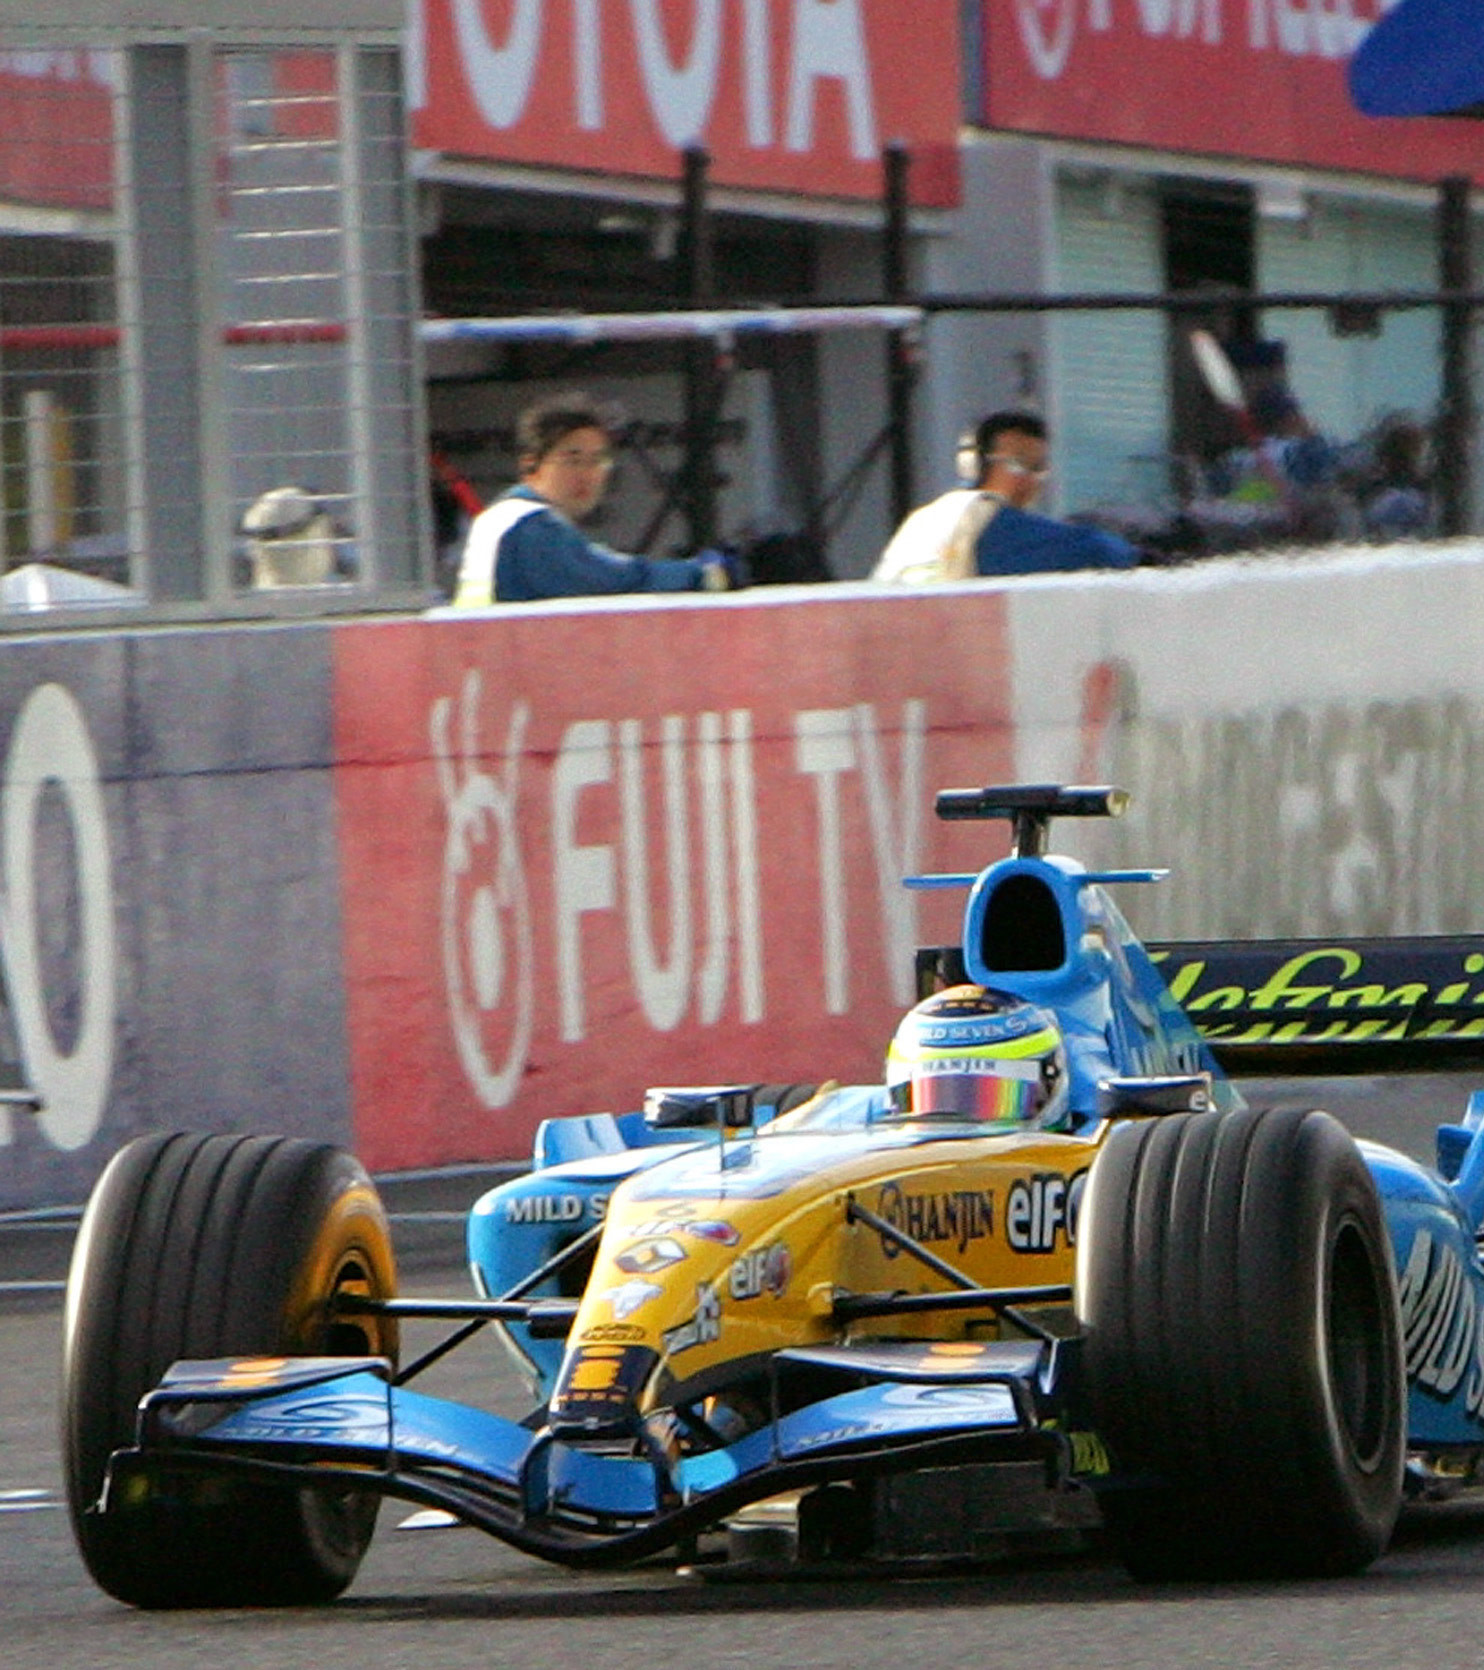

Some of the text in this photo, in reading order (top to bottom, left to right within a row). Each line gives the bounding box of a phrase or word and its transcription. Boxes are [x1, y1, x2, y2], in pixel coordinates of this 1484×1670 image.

[552, 698, 927, 1043] FUJI TV
[923, 1058, 996, 1073] HANJIN
[506, 1197, 582, 1222] MILD
[902, 1190, 994, 1253] HANJIN
[1007, 1173, 1066, 1253] elf
[730, 1254, 768, 1299] elf
